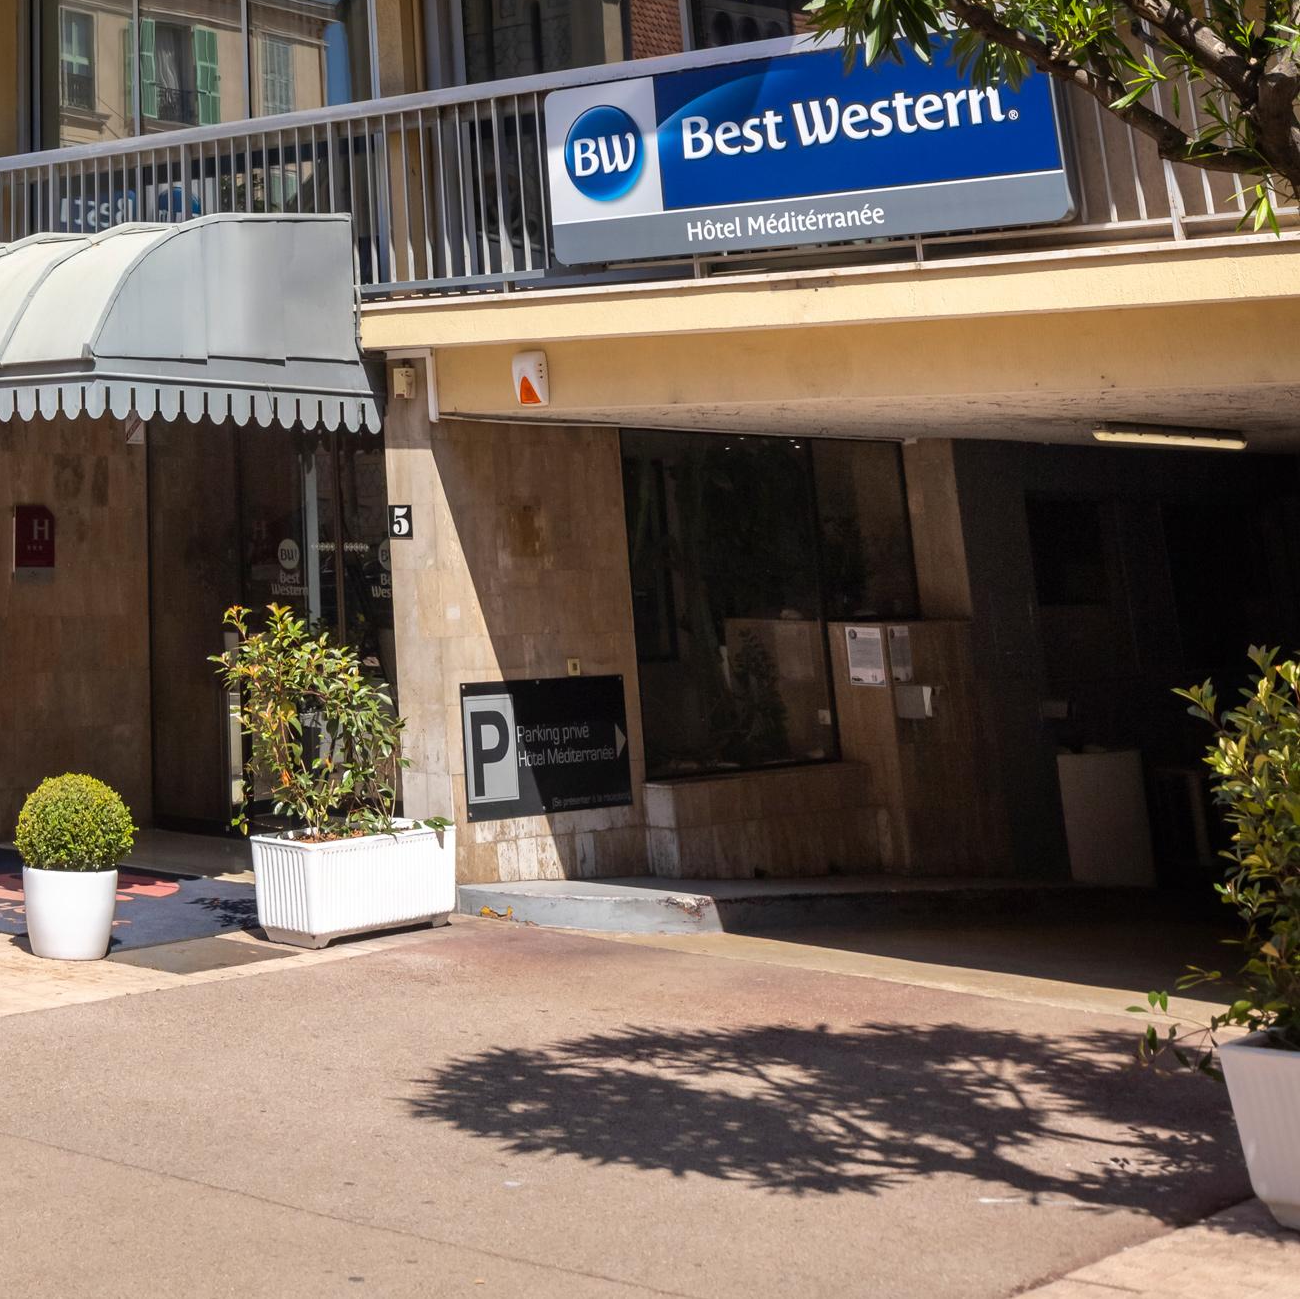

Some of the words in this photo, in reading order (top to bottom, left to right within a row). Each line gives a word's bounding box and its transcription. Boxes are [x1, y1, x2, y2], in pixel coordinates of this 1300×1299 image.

[681, 111, 786, 160] Best
[573, 132, 636, 177] BW
[686, 217, 741, 243] Hôtel
[746, 204, 885, 237] Méditérranée
[33, 519, 49, 540] H
[392, 507, 409, 536] 5
[381, 549, 390, 561] B
[280, 571, 300, 584] Best
[517, 725, 560, 745] Parking
[563, 722, 589, 744] privé
[470, 710, 510, 797] P
[518, 749, 545, 767] Hôtel
